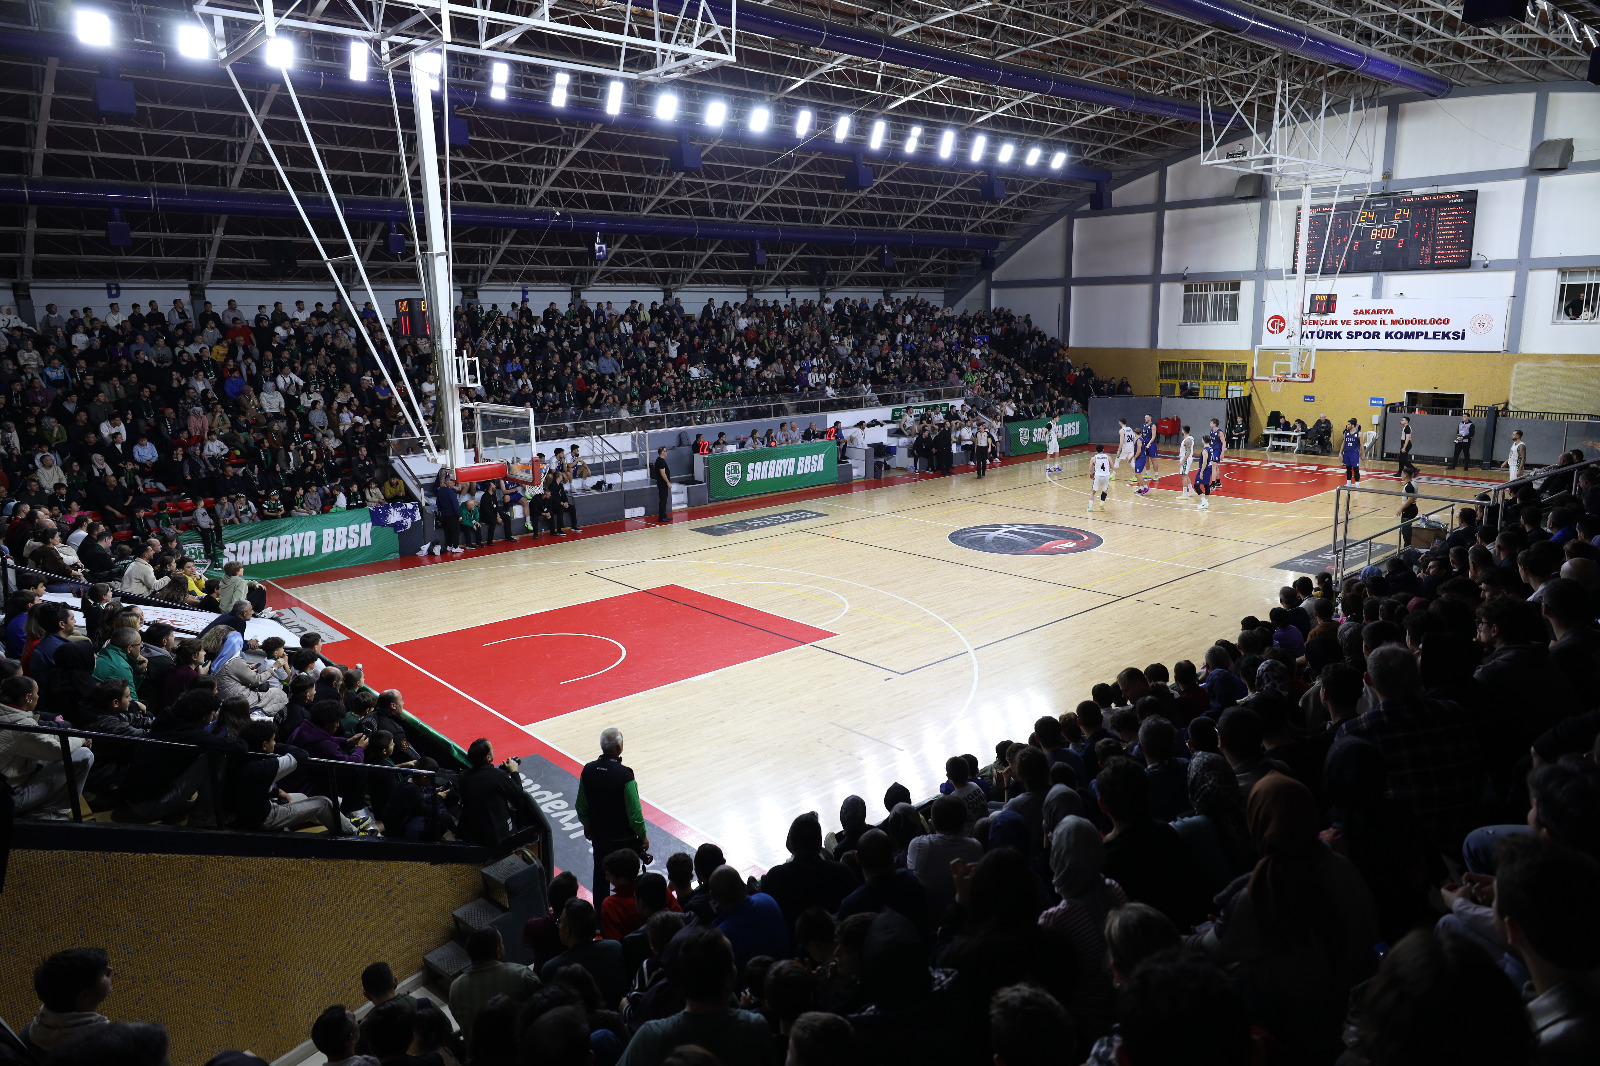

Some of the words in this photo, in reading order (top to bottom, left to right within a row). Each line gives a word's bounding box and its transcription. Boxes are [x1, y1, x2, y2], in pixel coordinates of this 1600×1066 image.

[1360, 211, 1375, 222] 24
[1394, 208, 1410, 219] 24
[1370, 227, 1396, 239] 8:00
[1353, 241, 1360, 250] 2
[1375, 240, 1381, 249] 2
[1397, 239, 1404, 248] 2
[106, 283, 121, 298] D
[1380, 317, 1388, 326] İL
[1346, 330, 1381, 340] SPOR
[1384, 328, 1466, 341] KOMPLEKSİ
[826, 427, 836, 440] 22
[699, 440, 710, 454] 22
[746, 457, 796, 482] SAKARYA
[796, 453, 826, 475] BBSK
[1100, 462, 1106, 472] 4
[223, 530, 317, 567] SAKARYA
[321, 522, 373, 554] BBSK
